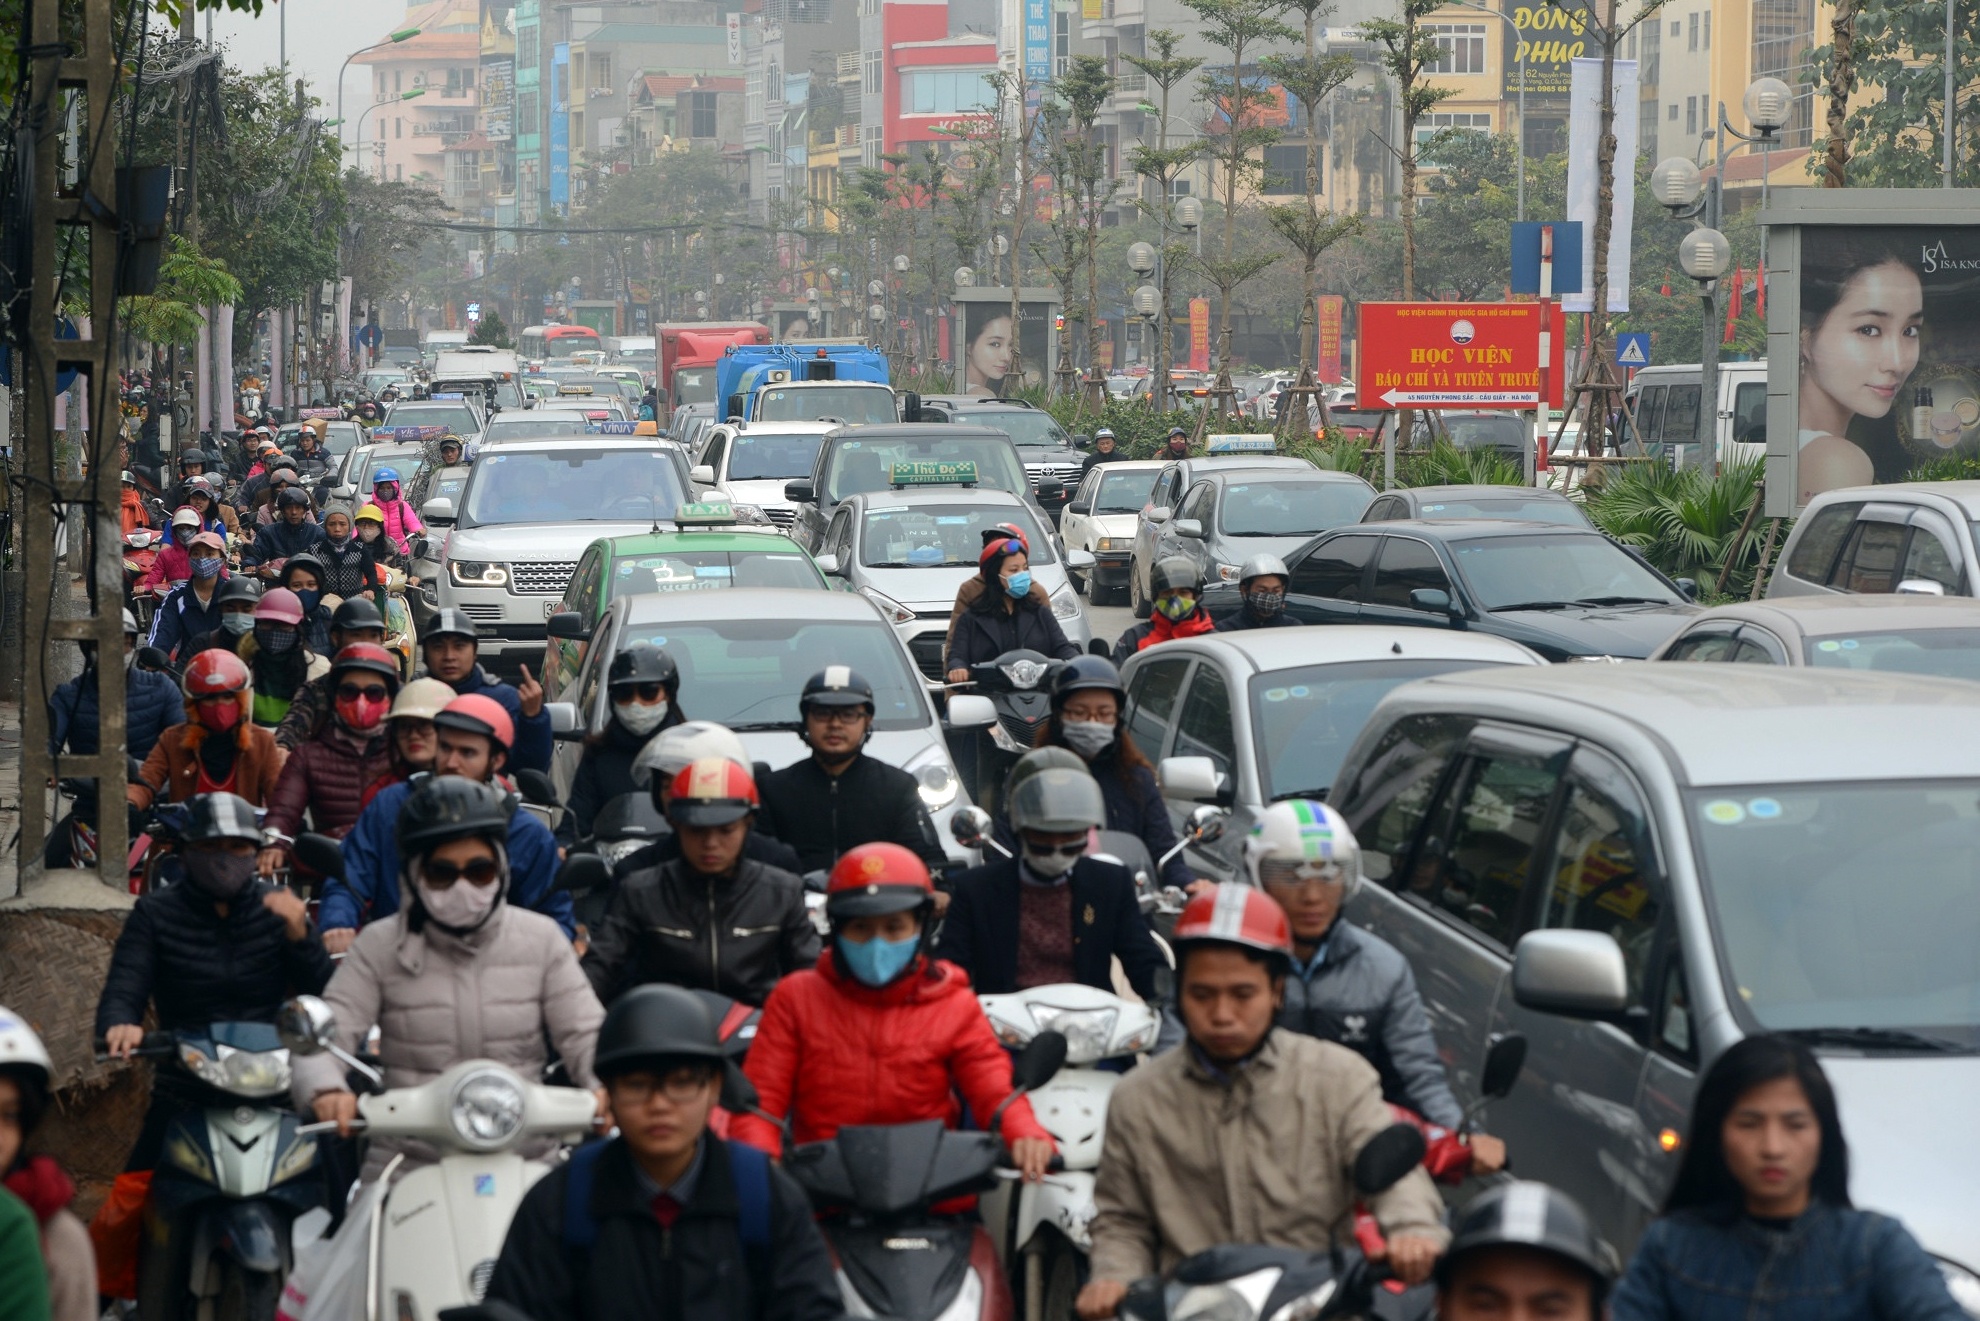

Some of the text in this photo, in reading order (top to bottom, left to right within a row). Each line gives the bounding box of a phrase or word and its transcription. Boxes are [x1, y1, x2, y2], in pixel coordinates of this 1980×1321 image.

[1027, 47, 1048, 63] TENNIS
[1514, 41, 1585, 71] PHỤC
[1030, 66, 1045, 75] 76
[1526, 69, 1537, 78] 62
[1940, 260, 1958, 269] ISA
[1396, 308, 1410, 317] HỌC
[1411, 308, 1426, 317] VIỆN
[1477, 308, 1488, 317] GIA
[1410, 344, 1512, 367] HỌC VIỆN
[1375, 367, 1539, 387] BÁO CHÍ VÀ TUYÊN TRUYỀ
